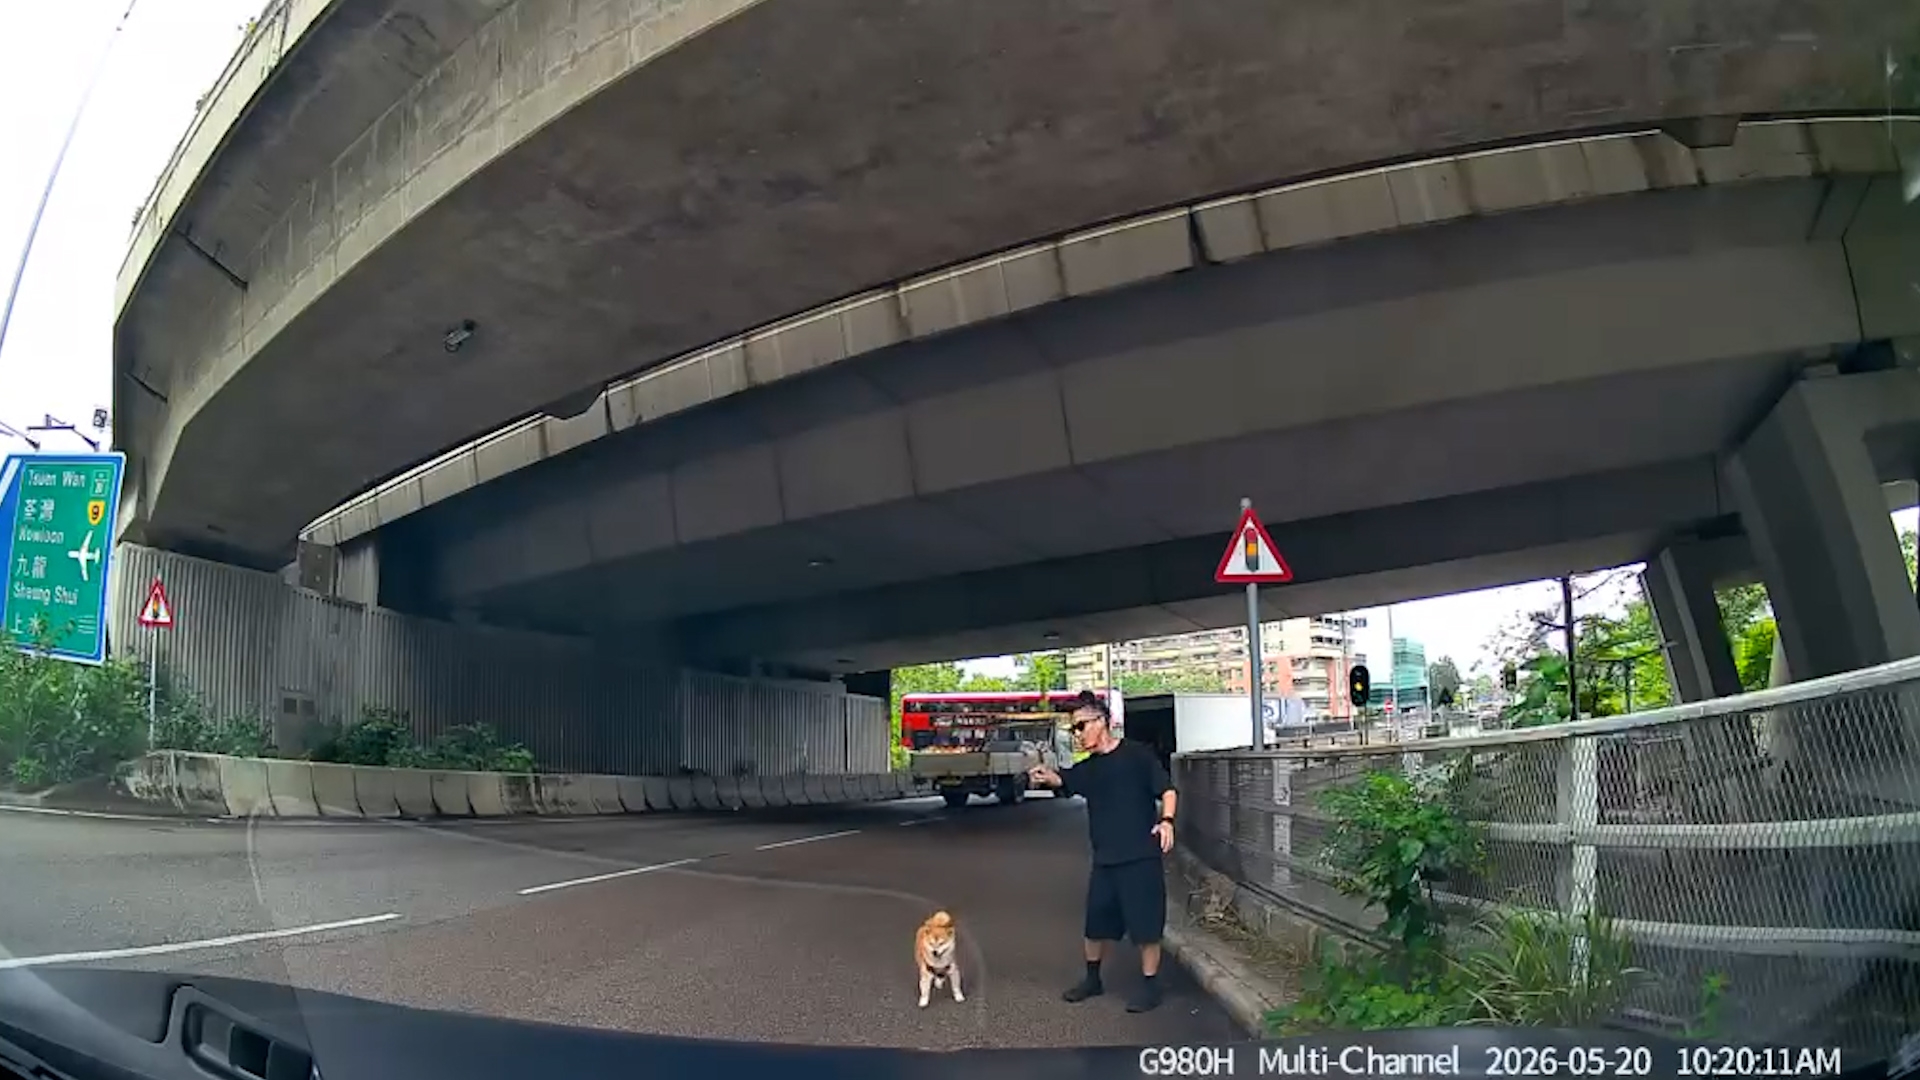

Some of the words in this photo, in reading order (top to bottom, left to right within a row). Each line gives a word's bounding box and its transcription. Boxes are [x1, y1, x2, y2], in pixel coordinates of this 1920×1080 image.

[28, 469, 57, 487] Tsuen
[61, 470, 86, 487] Wan
[90, 505, 100, 520] 9
[15, 553, 47, 579] 九龍
[13, 581, 51, 605] Sheung
[54, 587, 78, 606] Shui
[10, 611, 42, 636] 上水
